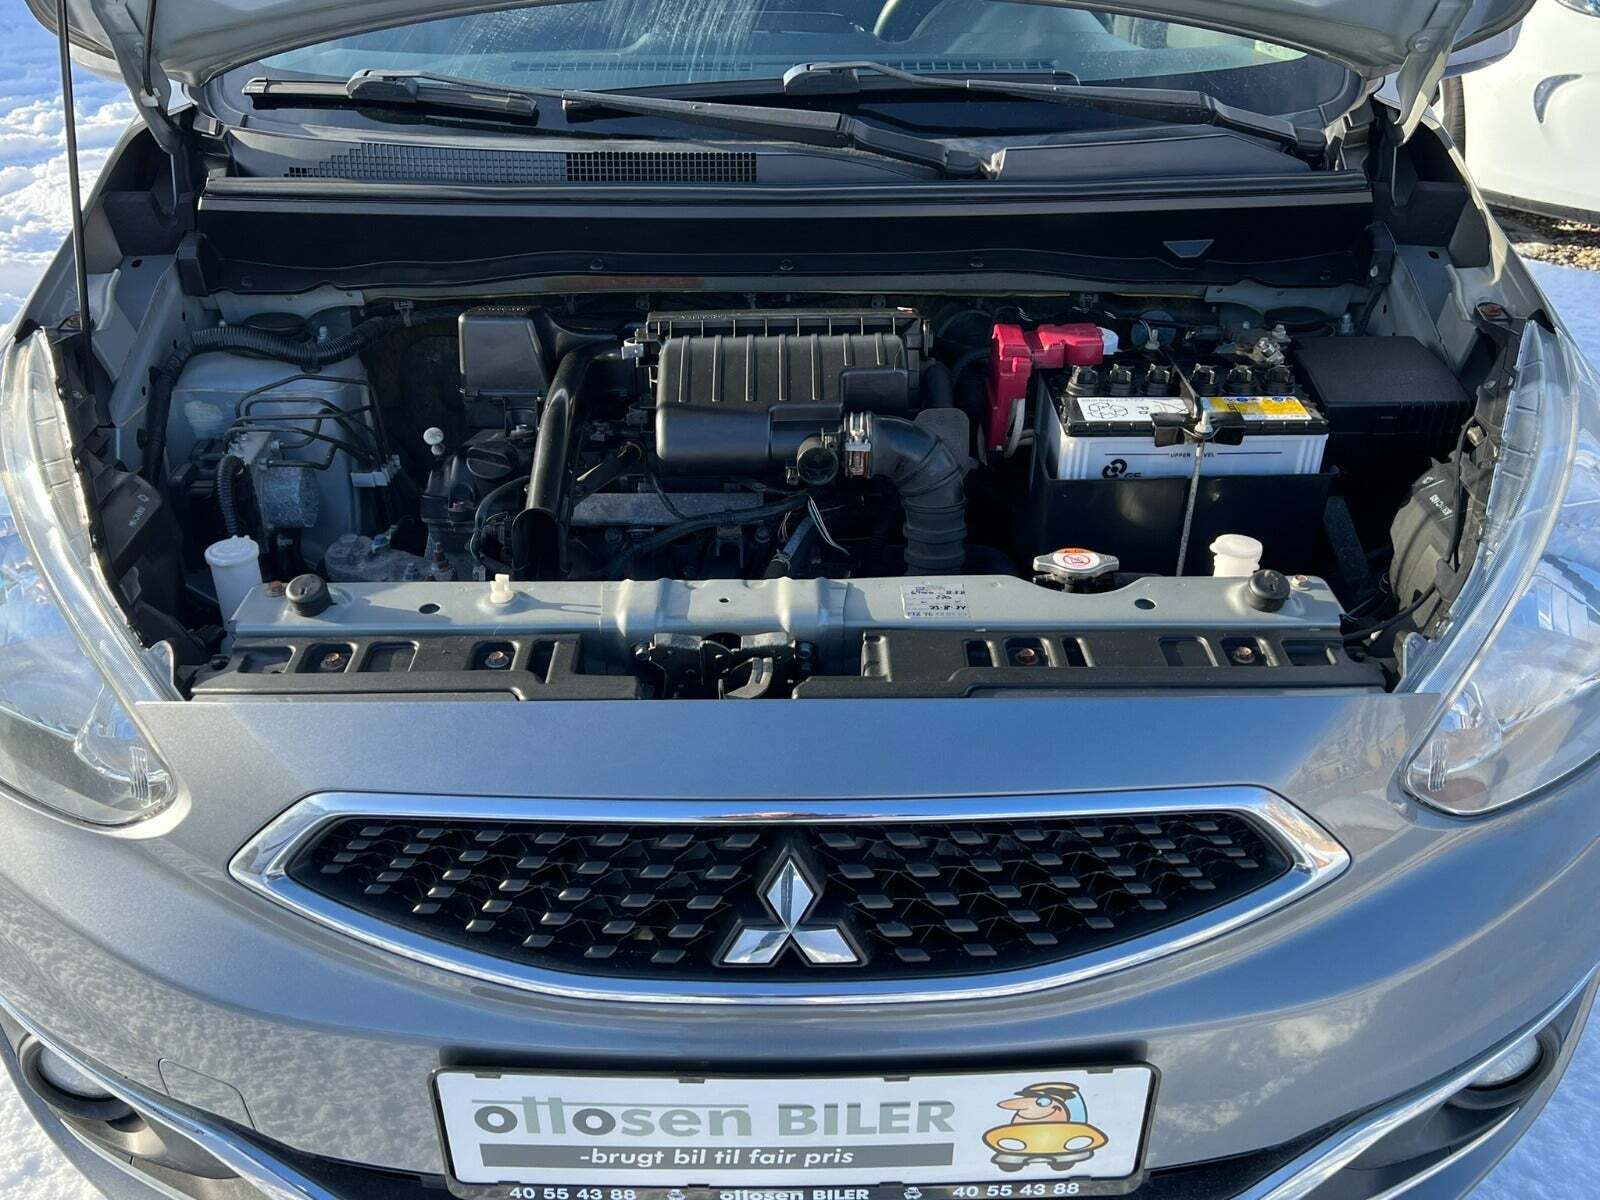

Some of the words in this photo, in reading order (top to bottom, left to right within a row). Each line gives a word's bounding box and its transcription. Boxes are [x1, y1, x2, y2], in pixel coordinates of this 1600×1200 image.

[472, 1096, 752, 1136] ottosen
[778, 1100, 955, 1137] BILER
[580, 1148, 665, 1168] -brugt
[674, 1148, 707, 1165] bil
[714, 1148, 740, 1164] til
[748, 1148, 797, 1164] fair
[804, 1148, 854, 1168] pris
[509, 1187, 536, 1200] 40
[543, 1188, 569, 1200] 55
[576, 1188, 603, 1200] 43
[610, 1188, 637, 1200] 88
[813, 1189, 870, 1200] BILER
[952, 1185, 979, 1198] 40
[986, 1184, 1013, 1197] 55
[1019, 1183, 1046, 1196] 43
[1053, 1182, 1080, 1195] 88
